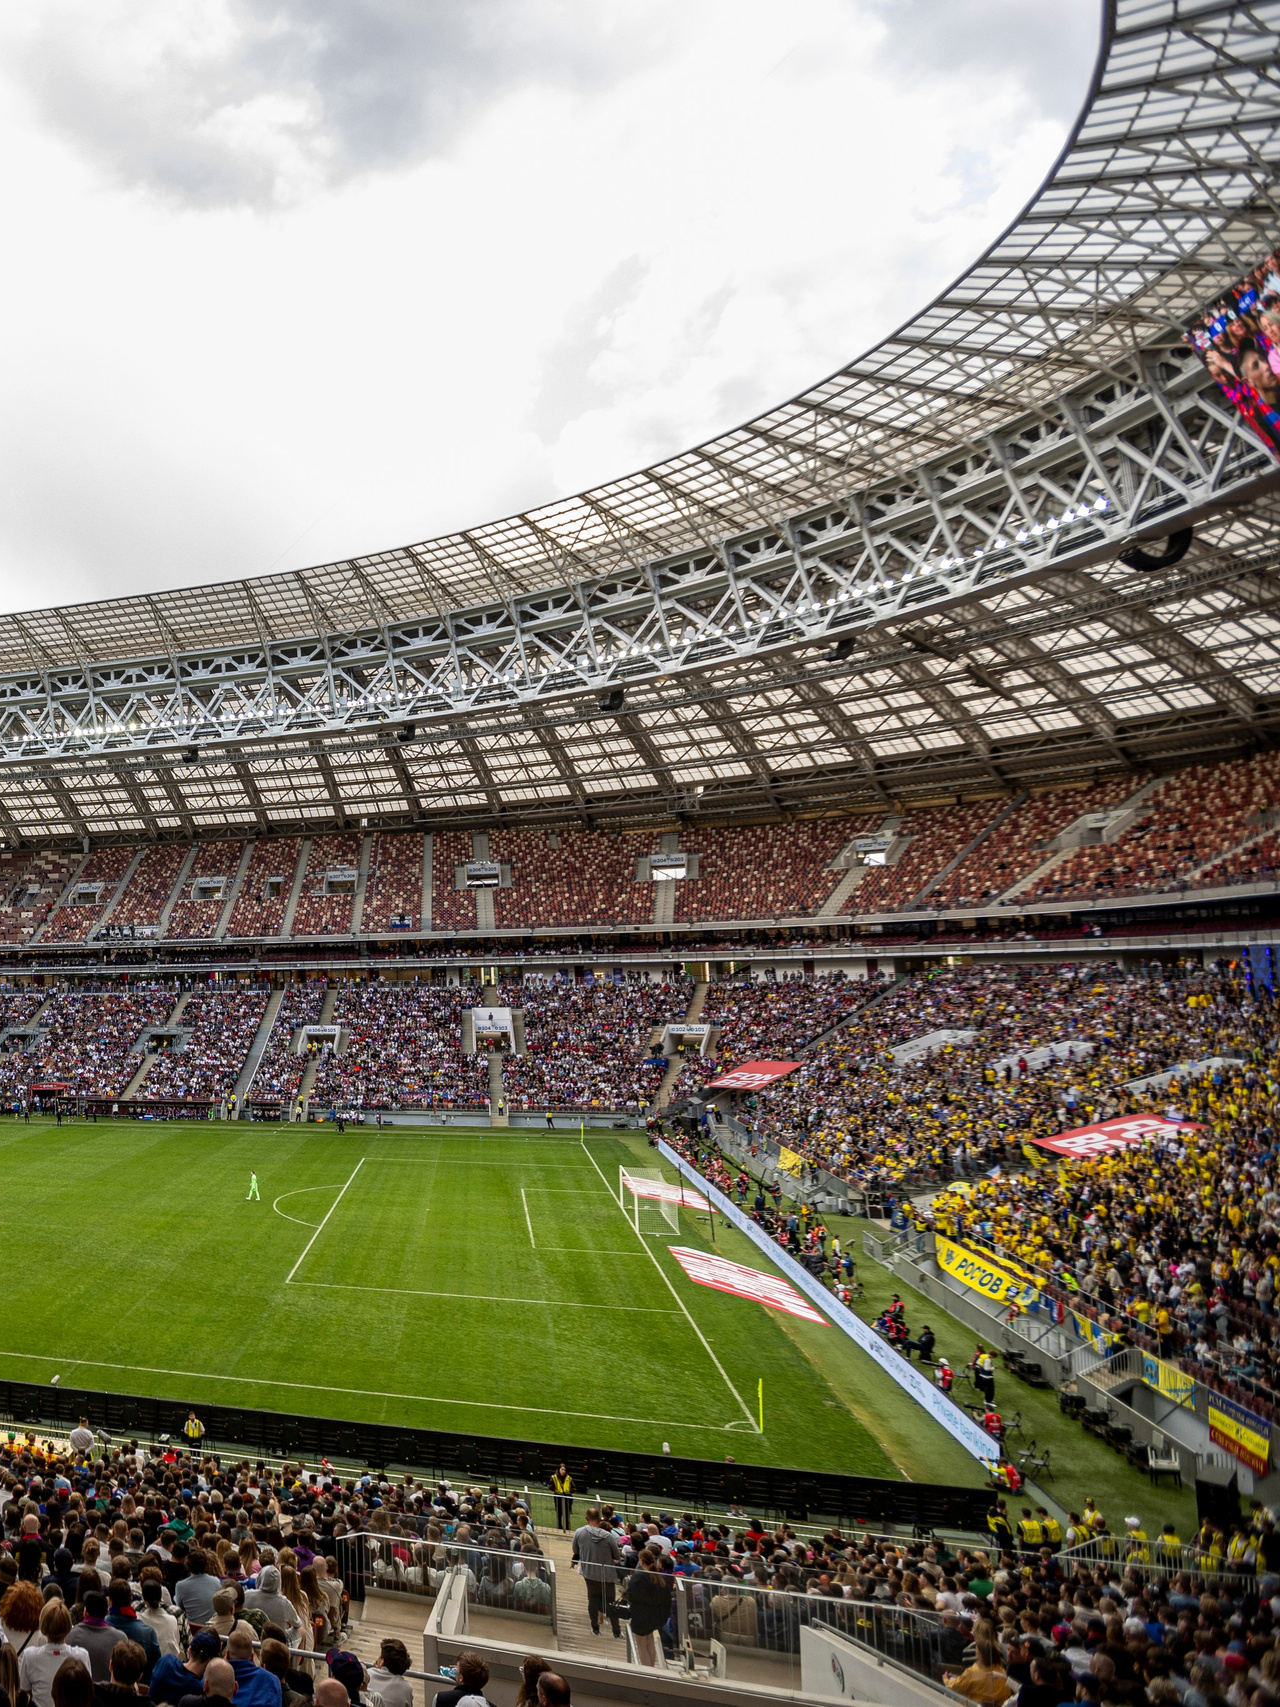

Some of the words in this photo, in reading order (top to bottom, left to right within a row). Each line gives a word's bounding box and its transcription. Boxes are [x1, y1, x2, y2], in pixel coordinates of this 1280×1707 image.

[711, 1079, 768, 1088] BET
[724, 1072, 782, 1081] FON
[1049, 1132, 1128, 1157] BE
[932, 1393, 959, 1429] Private
